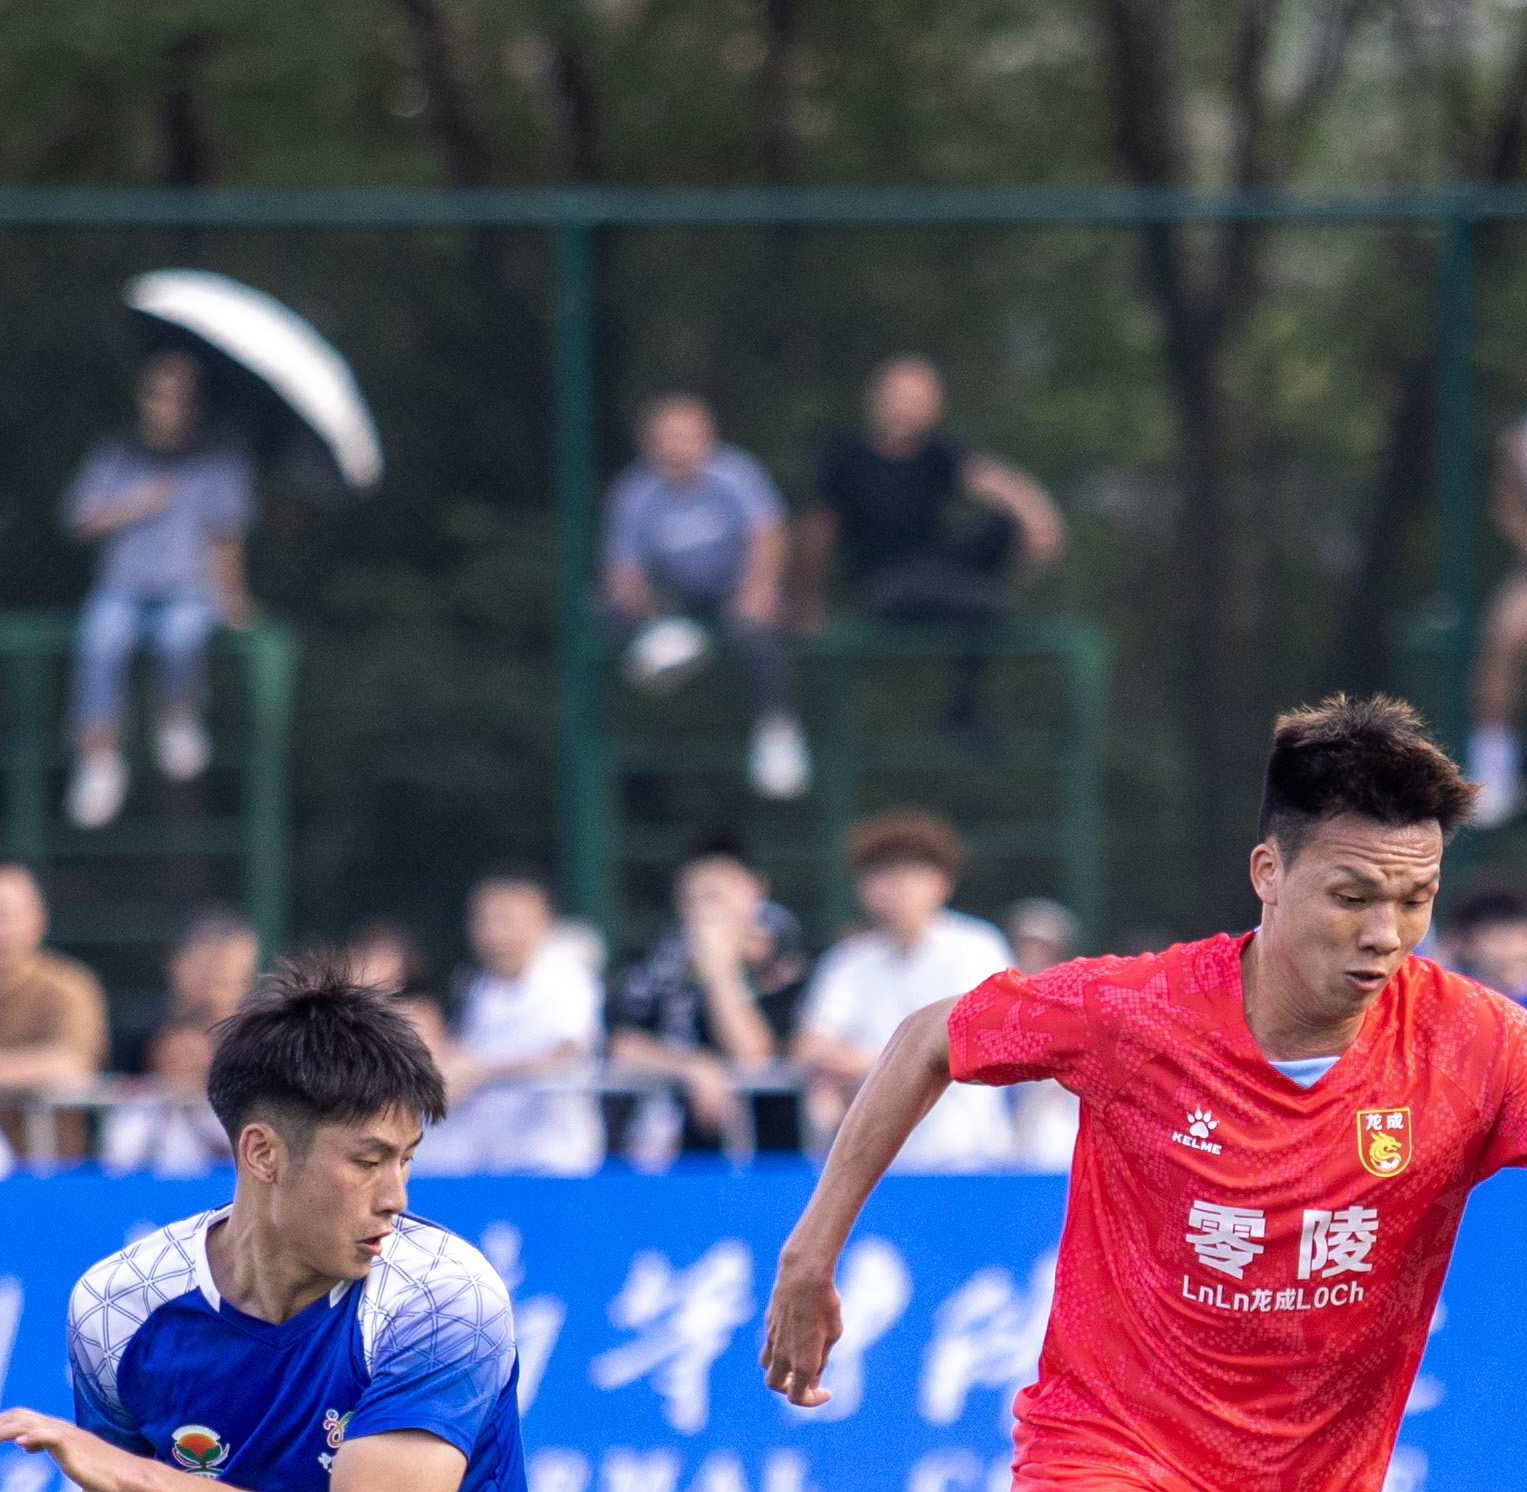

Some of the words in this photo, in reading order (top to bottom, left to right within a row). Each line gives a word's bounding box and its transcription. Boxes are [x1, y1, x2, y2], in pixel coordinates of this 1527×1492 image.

[1365, 1112, 1404, 1131] 龙成
[1172, 1131, 1222, 1155] KELME
[1185, 1199, 1379, 1280] 零陵
